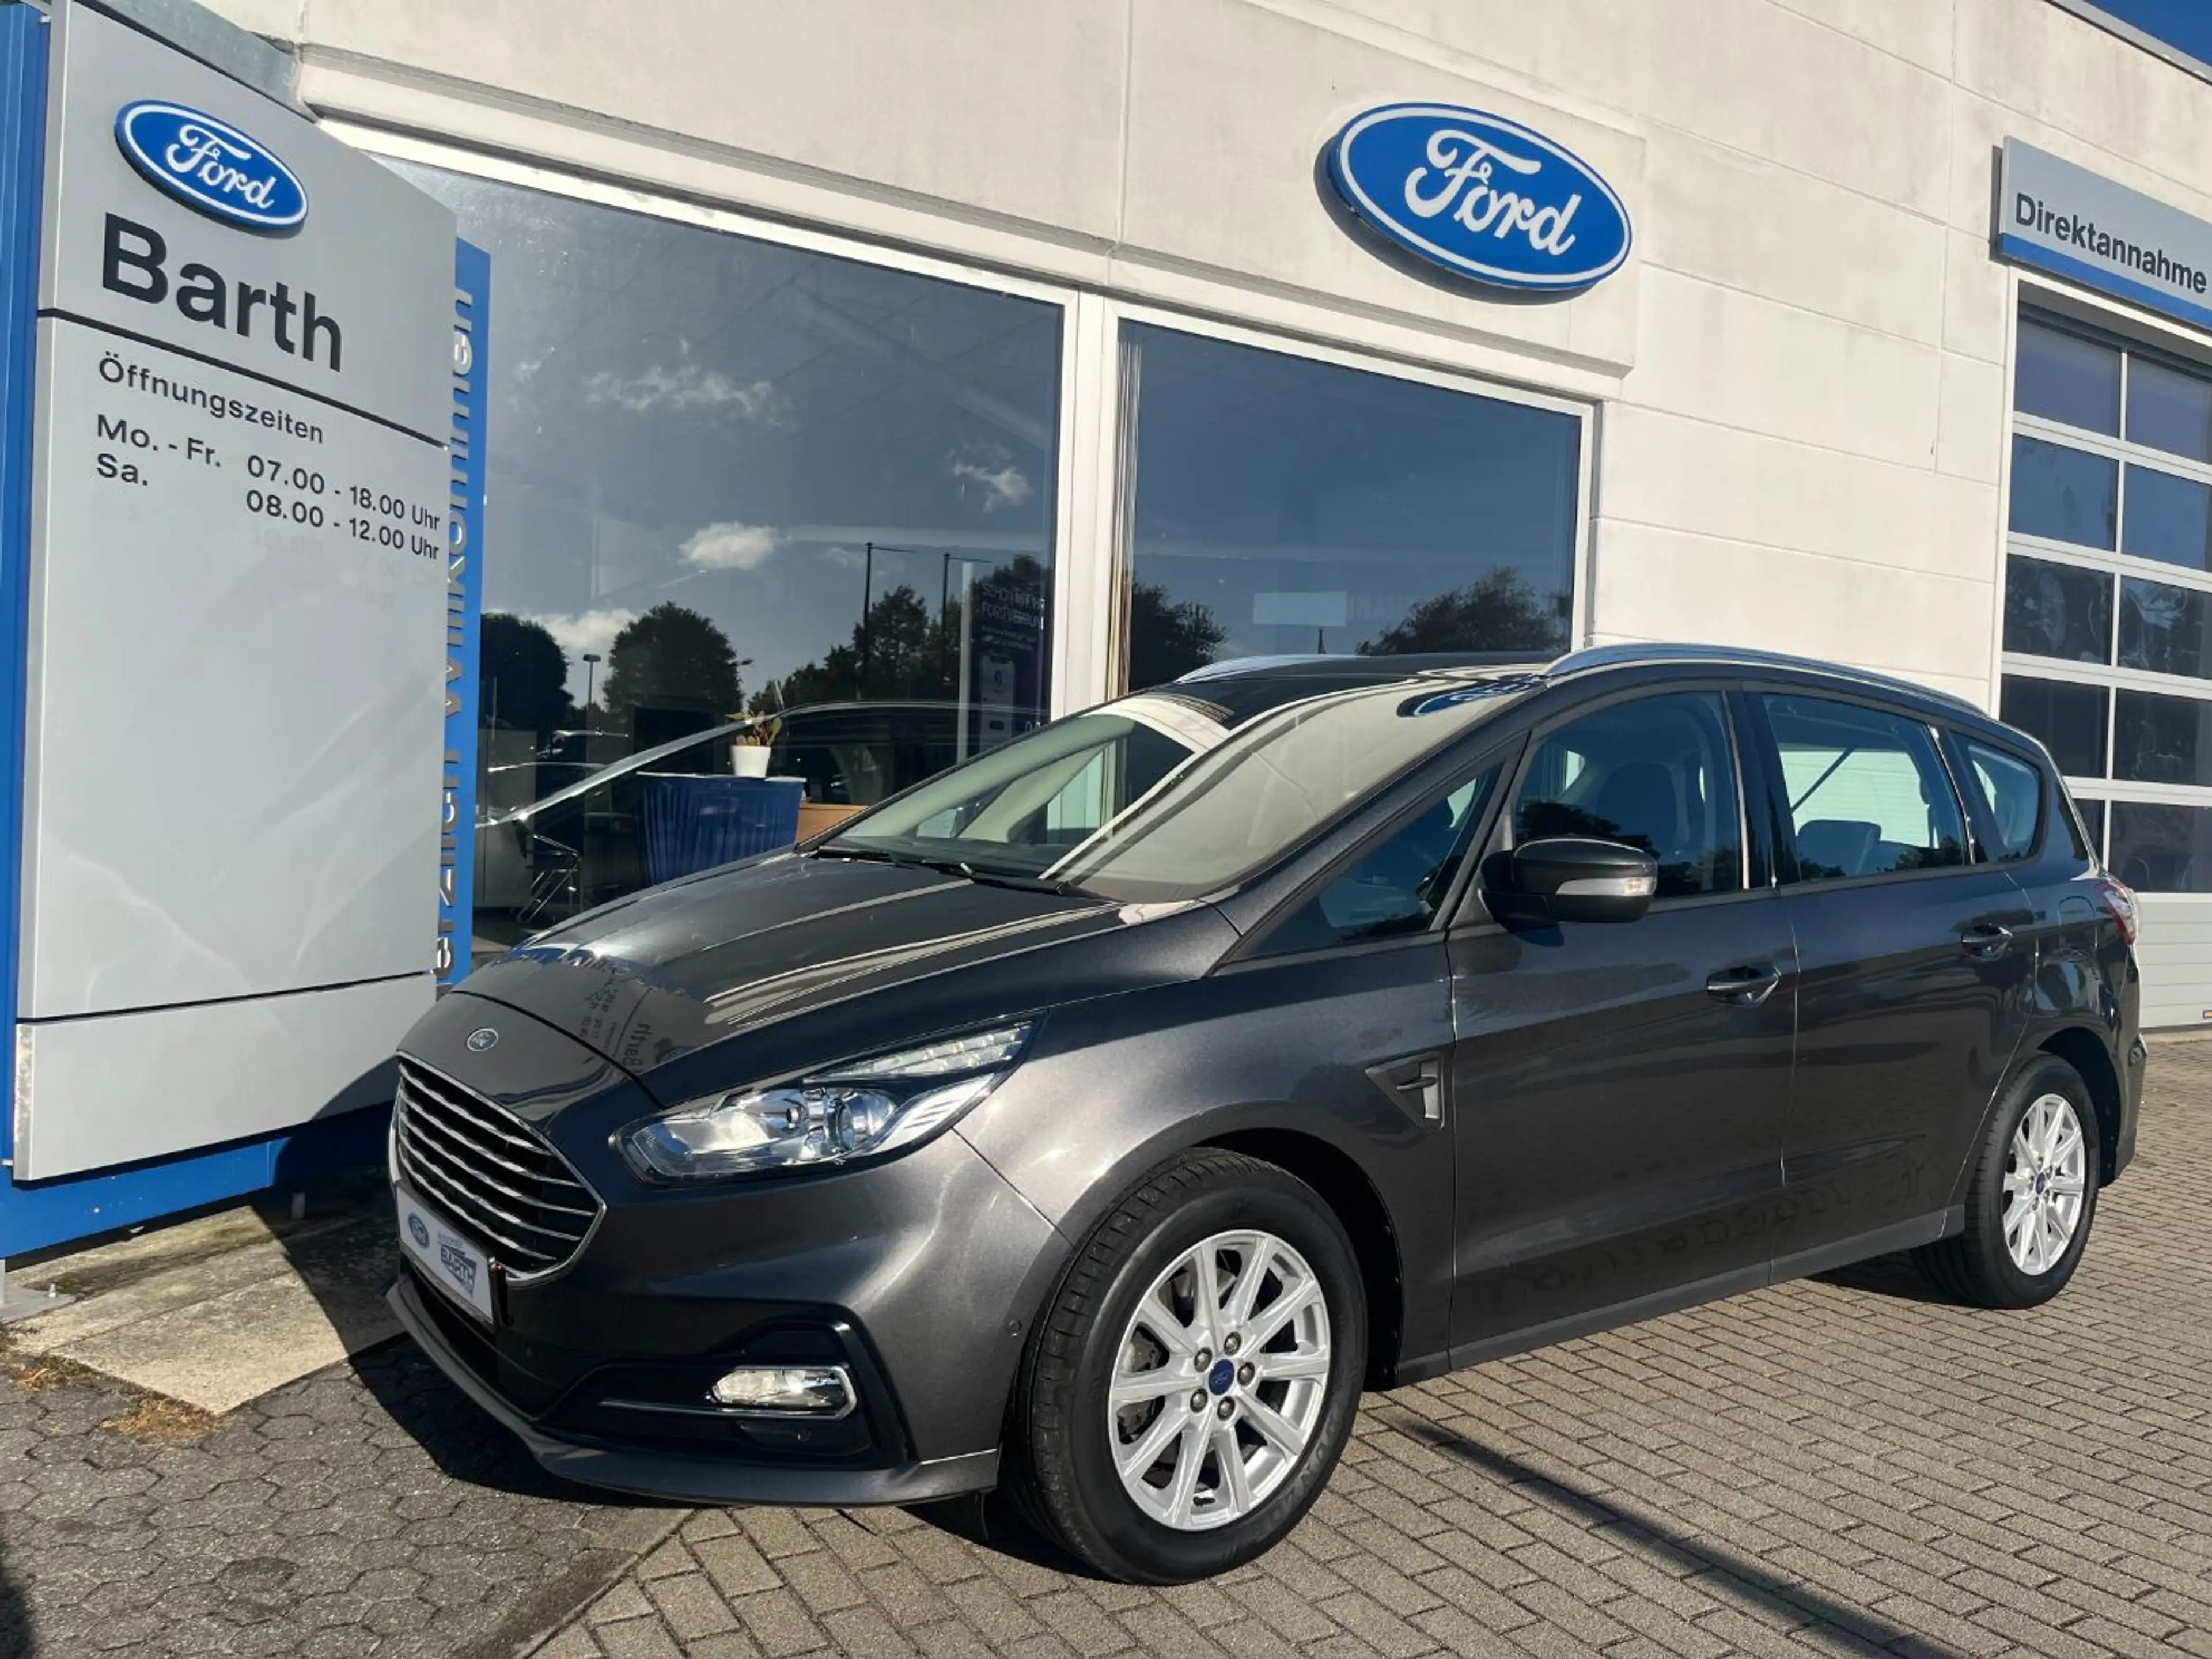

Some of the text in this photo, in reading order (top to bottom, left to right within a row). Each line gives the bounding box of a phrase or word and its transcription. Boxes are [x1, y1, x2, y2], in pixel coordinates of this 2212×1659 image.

[165, 123, 278, 210] Ford
[1404, 129, 1582, 256] Ford
[101, 212, 343, 373] Barth
[2016, 192, 2207, 294] Direktannahme
[99, 351, 324, 444] Öffnungszeiten
[96, 453, 149, 487] Sa.
[246, 490, 324, 529] 08.00
[349, 518, 405, 551] 12.00
[411, 535, 440, 561] Uhr
[97, 414, 158, 452] Mo.
[187, 438, 222, 468] Fr.
[247, 454, 325, 495] 07.00
[350, 486, 406, 521] 18.00
[412, 505, 441, 532] Uhr
